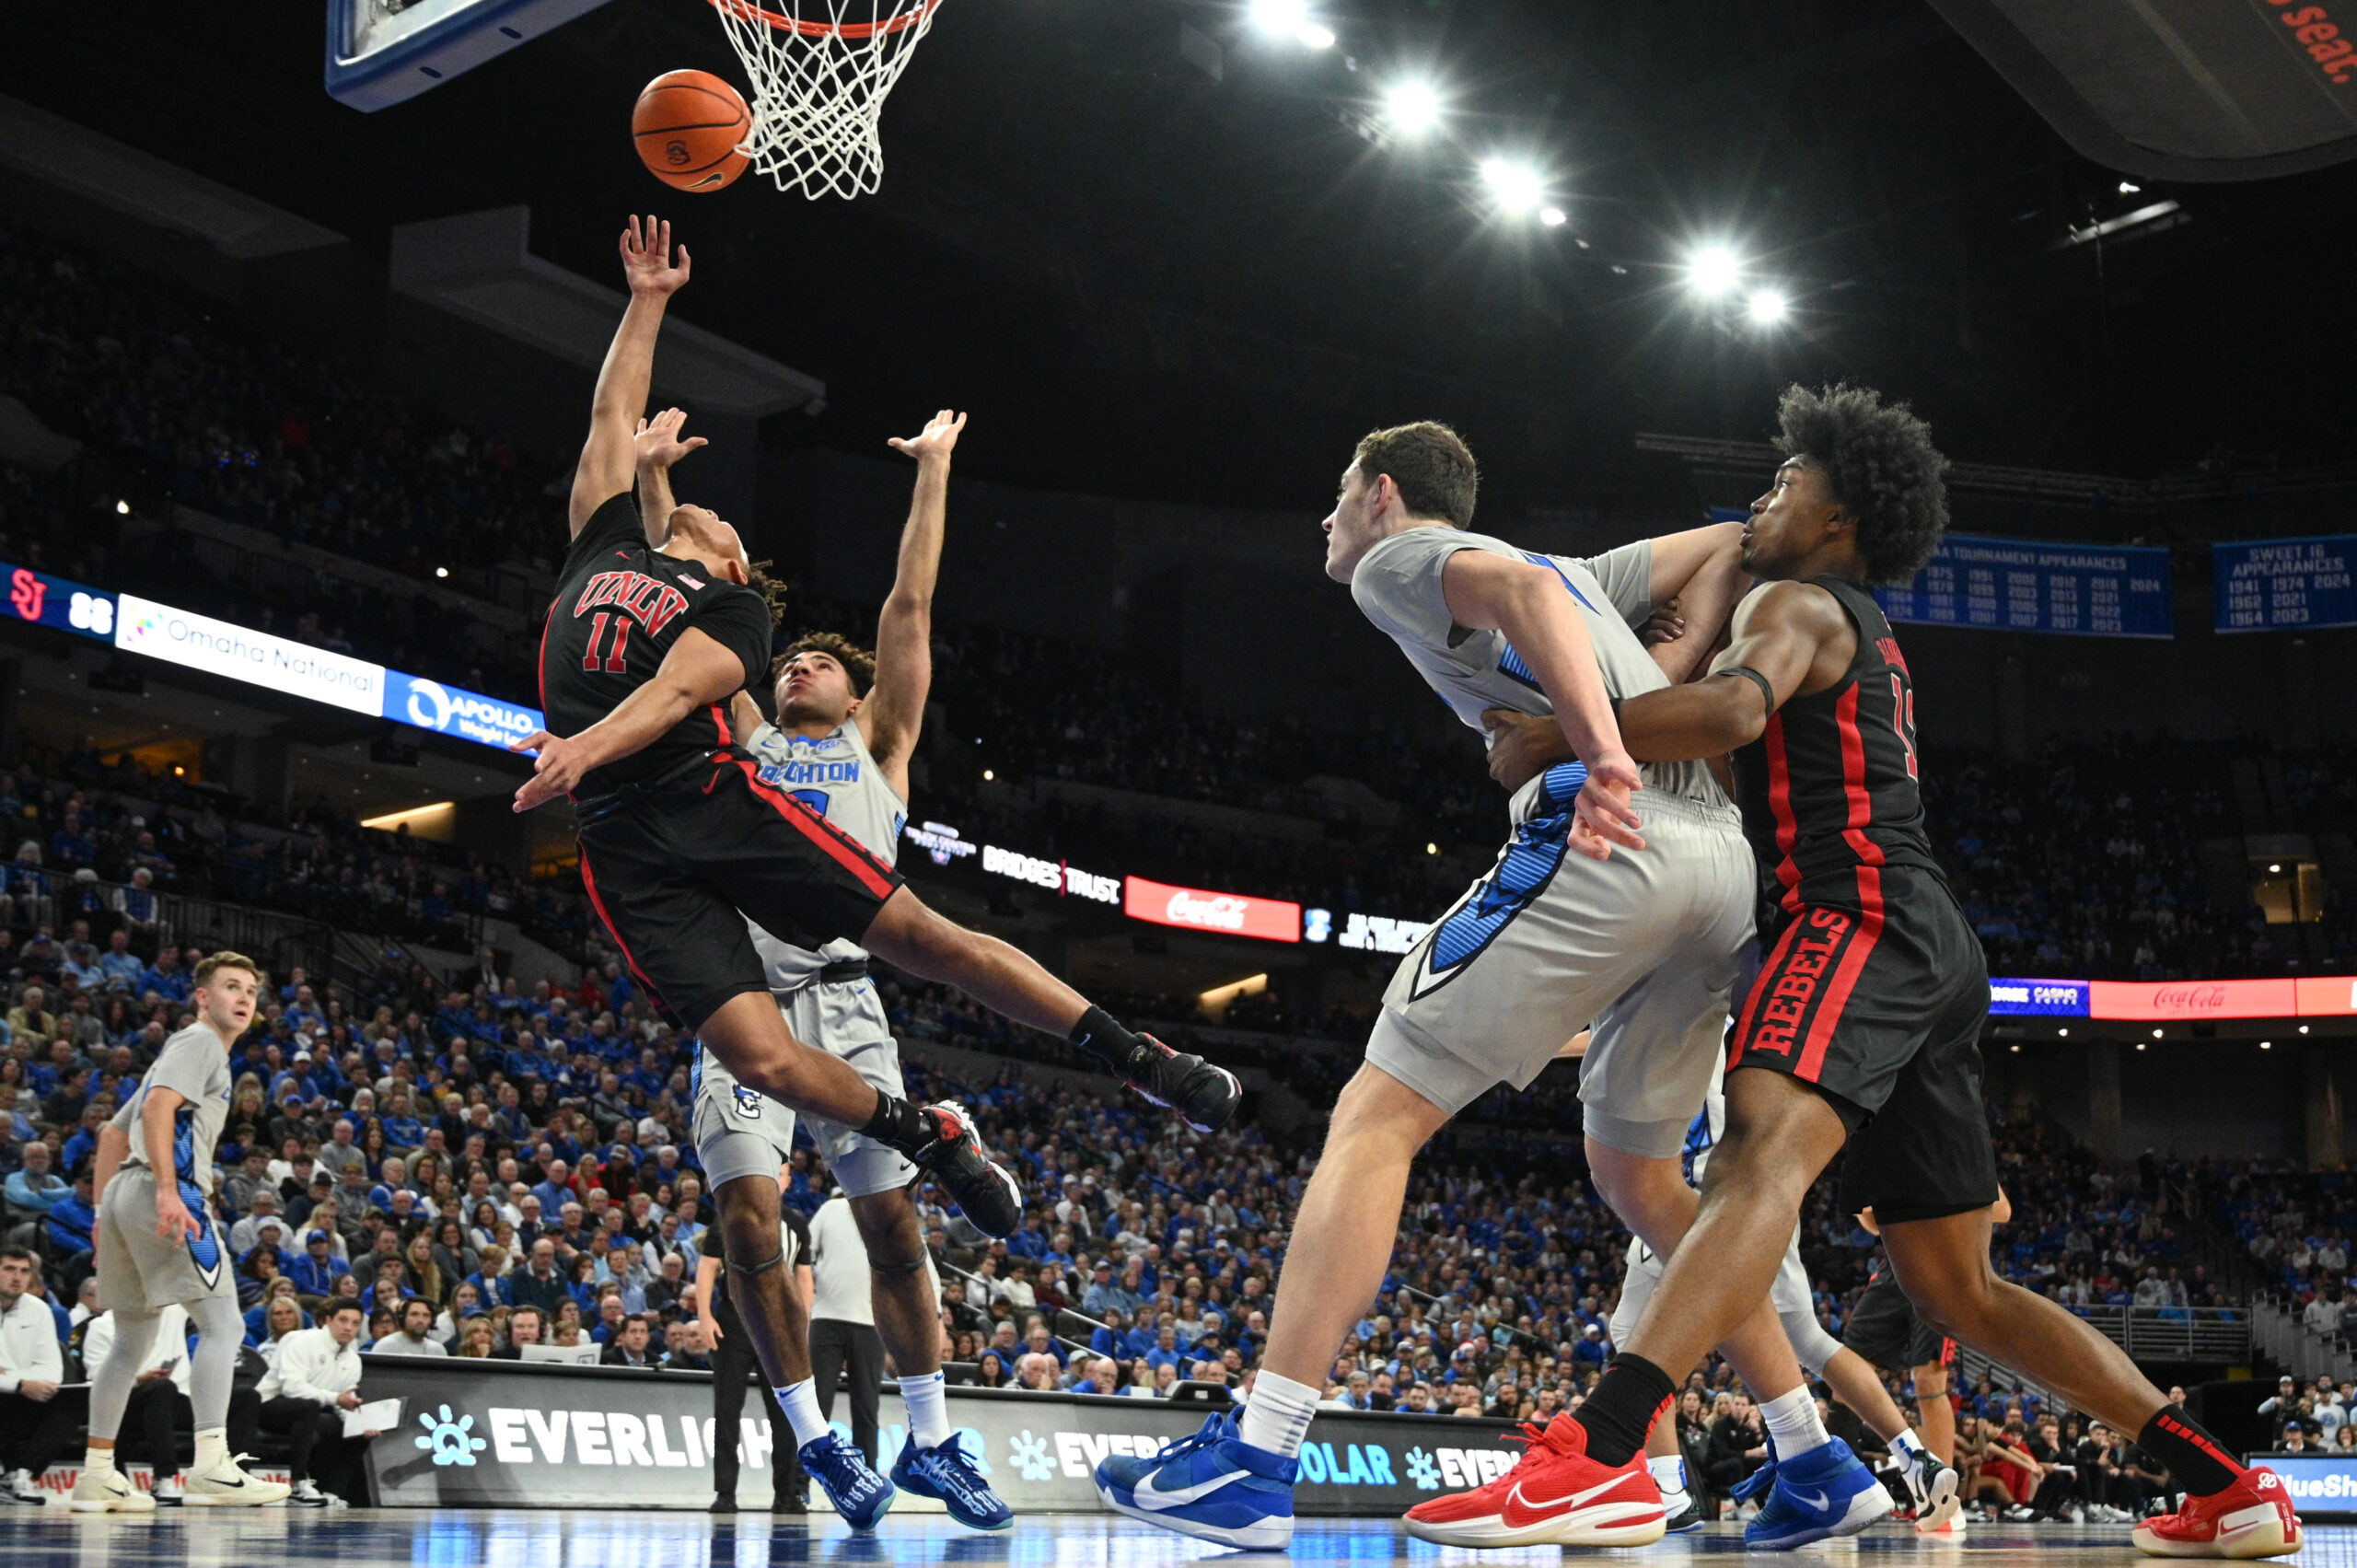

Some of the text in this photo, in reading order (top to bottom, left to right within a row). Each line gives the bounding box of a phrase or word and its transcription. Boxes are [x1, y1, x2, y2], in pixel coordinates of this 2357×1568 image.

[1953, 547, 2036, 564] TOURNAMENT
[2038, 553, 2127, 571] APPEARANCES
[2233, 557, 2344, 577] APPEARANCES
[2250, 544, 2325, 561] SWEET 16
[2131, 578, 2161, 592] 2024
[2229, 575, 2351, 594] 1941 1974 2024
[574, 571, 689, 638] UNLV
[2272, 593, 2306, 608] 2021
[168, 619, 374, 693] Omaha National
[583, 612, 633, 674] 11
[450, 696, 533, 734] APOLLO
[982, 844, 1062, 889] BRIDGES
[1751, 907, 1851, 1057] REBELS
[1295, 1441, 1398, 1485] OLAR
[2277, 1474, 2357, 1498] lueSh
